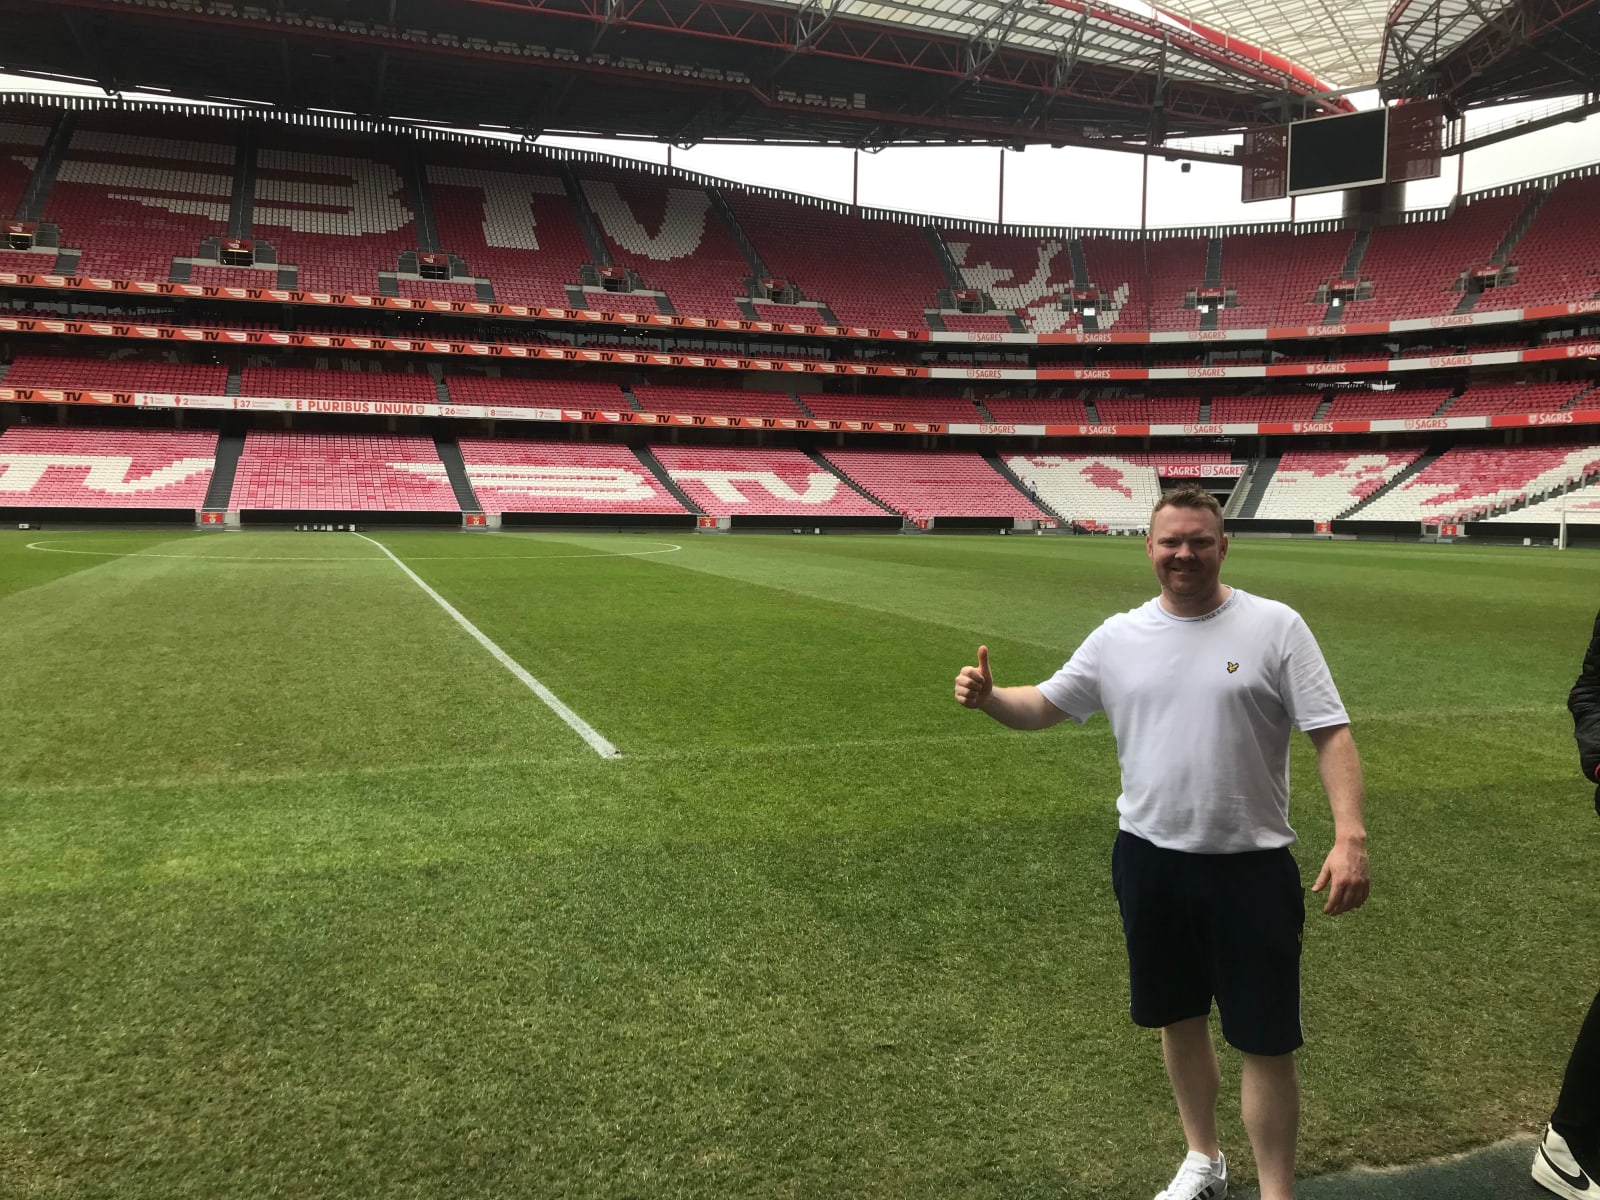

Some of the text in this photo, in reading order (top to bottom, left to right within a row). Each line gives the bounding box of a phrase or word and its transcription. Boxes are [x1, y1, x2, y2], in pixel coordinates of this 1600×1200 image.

[1440, 315, 1473, 325] SAGRES
[1316, 325, 1346, 336] SAGRES
[977, 332, 1002, 342] SAGRES
[1084, 333, 1112, 343] SAGRES
[1198, 331, 1226, 341] SAGRES
[1440, 355, 1472, 367] SAGRES
[1198, 368, 1226, 378] SAGRES
[1316, 363, 1346, 374] SAGRES
[976, 369, 1002, 379] SAGRES
[1083, 370, 1110, 379] SAGRES
[296, 401, 414, 414] E PLURIBUS UNUM
[1538, 412, 1573, 424] SAGRES
[989, 424, 1016, 434] SAGRES
[1192, 424, 1223, 433] SAGRES
[1302, 422, 1334, 433] SAGRES
[1415, 419, 1447, 429] SAGRES
[1088, 425, 1116, 435] SAGRES
[1168, 466, 1200, 476] SAGRES
[1213, 466, 1245, 476] SAGRES
